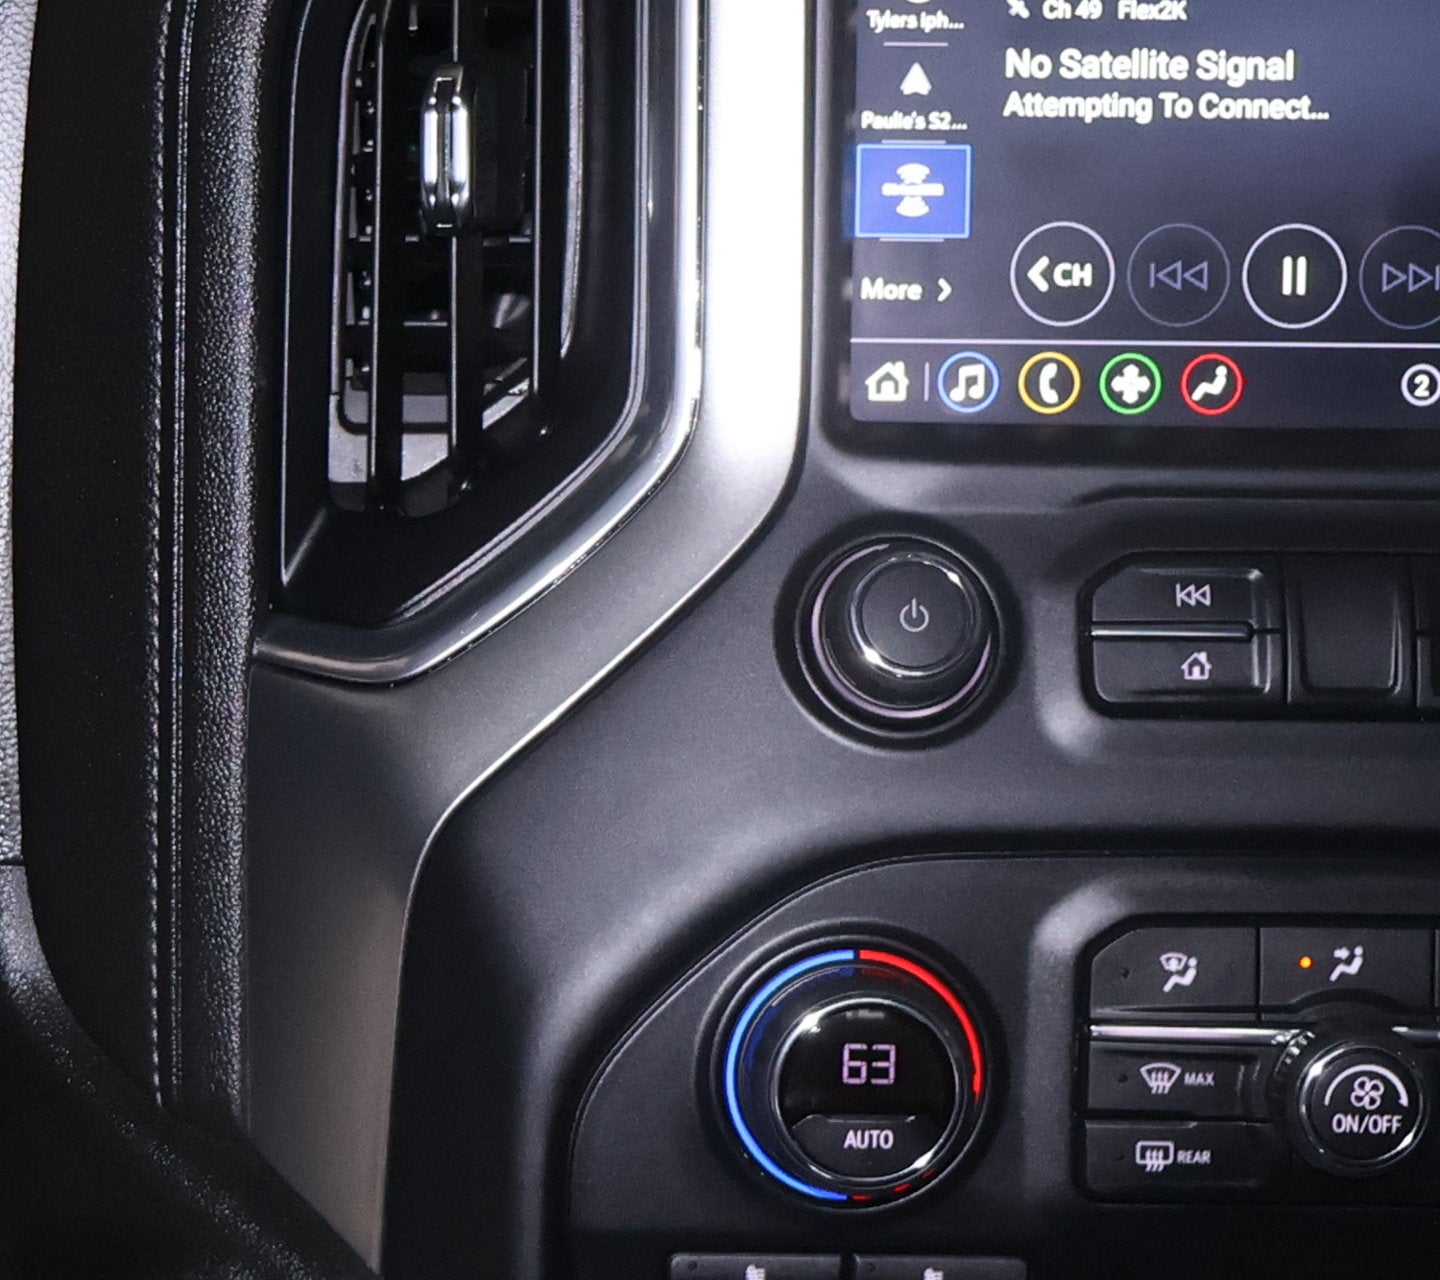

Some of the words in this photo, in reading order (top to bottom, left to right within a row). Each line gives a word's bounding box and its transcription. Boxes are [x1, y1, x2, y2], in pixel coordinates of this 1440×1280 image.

[1075, 0, 1103, 20] 49
[1005, 47, 1052, 79] No
[1059, 47, 1190, 80] Satellite
[1195, 48, 1295, 88] Signal
[1002, 90, 1154, 124] Attempting
[1158, 91, 1195, 120] To
[1198, 91, 1331, 121] Connect...
[1052, 261, 1094, 288] CH
[860, 276, 923, 301] More
[1413, 374, 1432, 397] 2
[842, 1043, 897, 1085] 63
[1184, 1071, 1216, 1088] MAX
[1331, 1113, 1404, 1136] ON/OFF
[843, 1129, 895, 1150] AUTO
[1177, 1150, 1213, 1166] REAR
